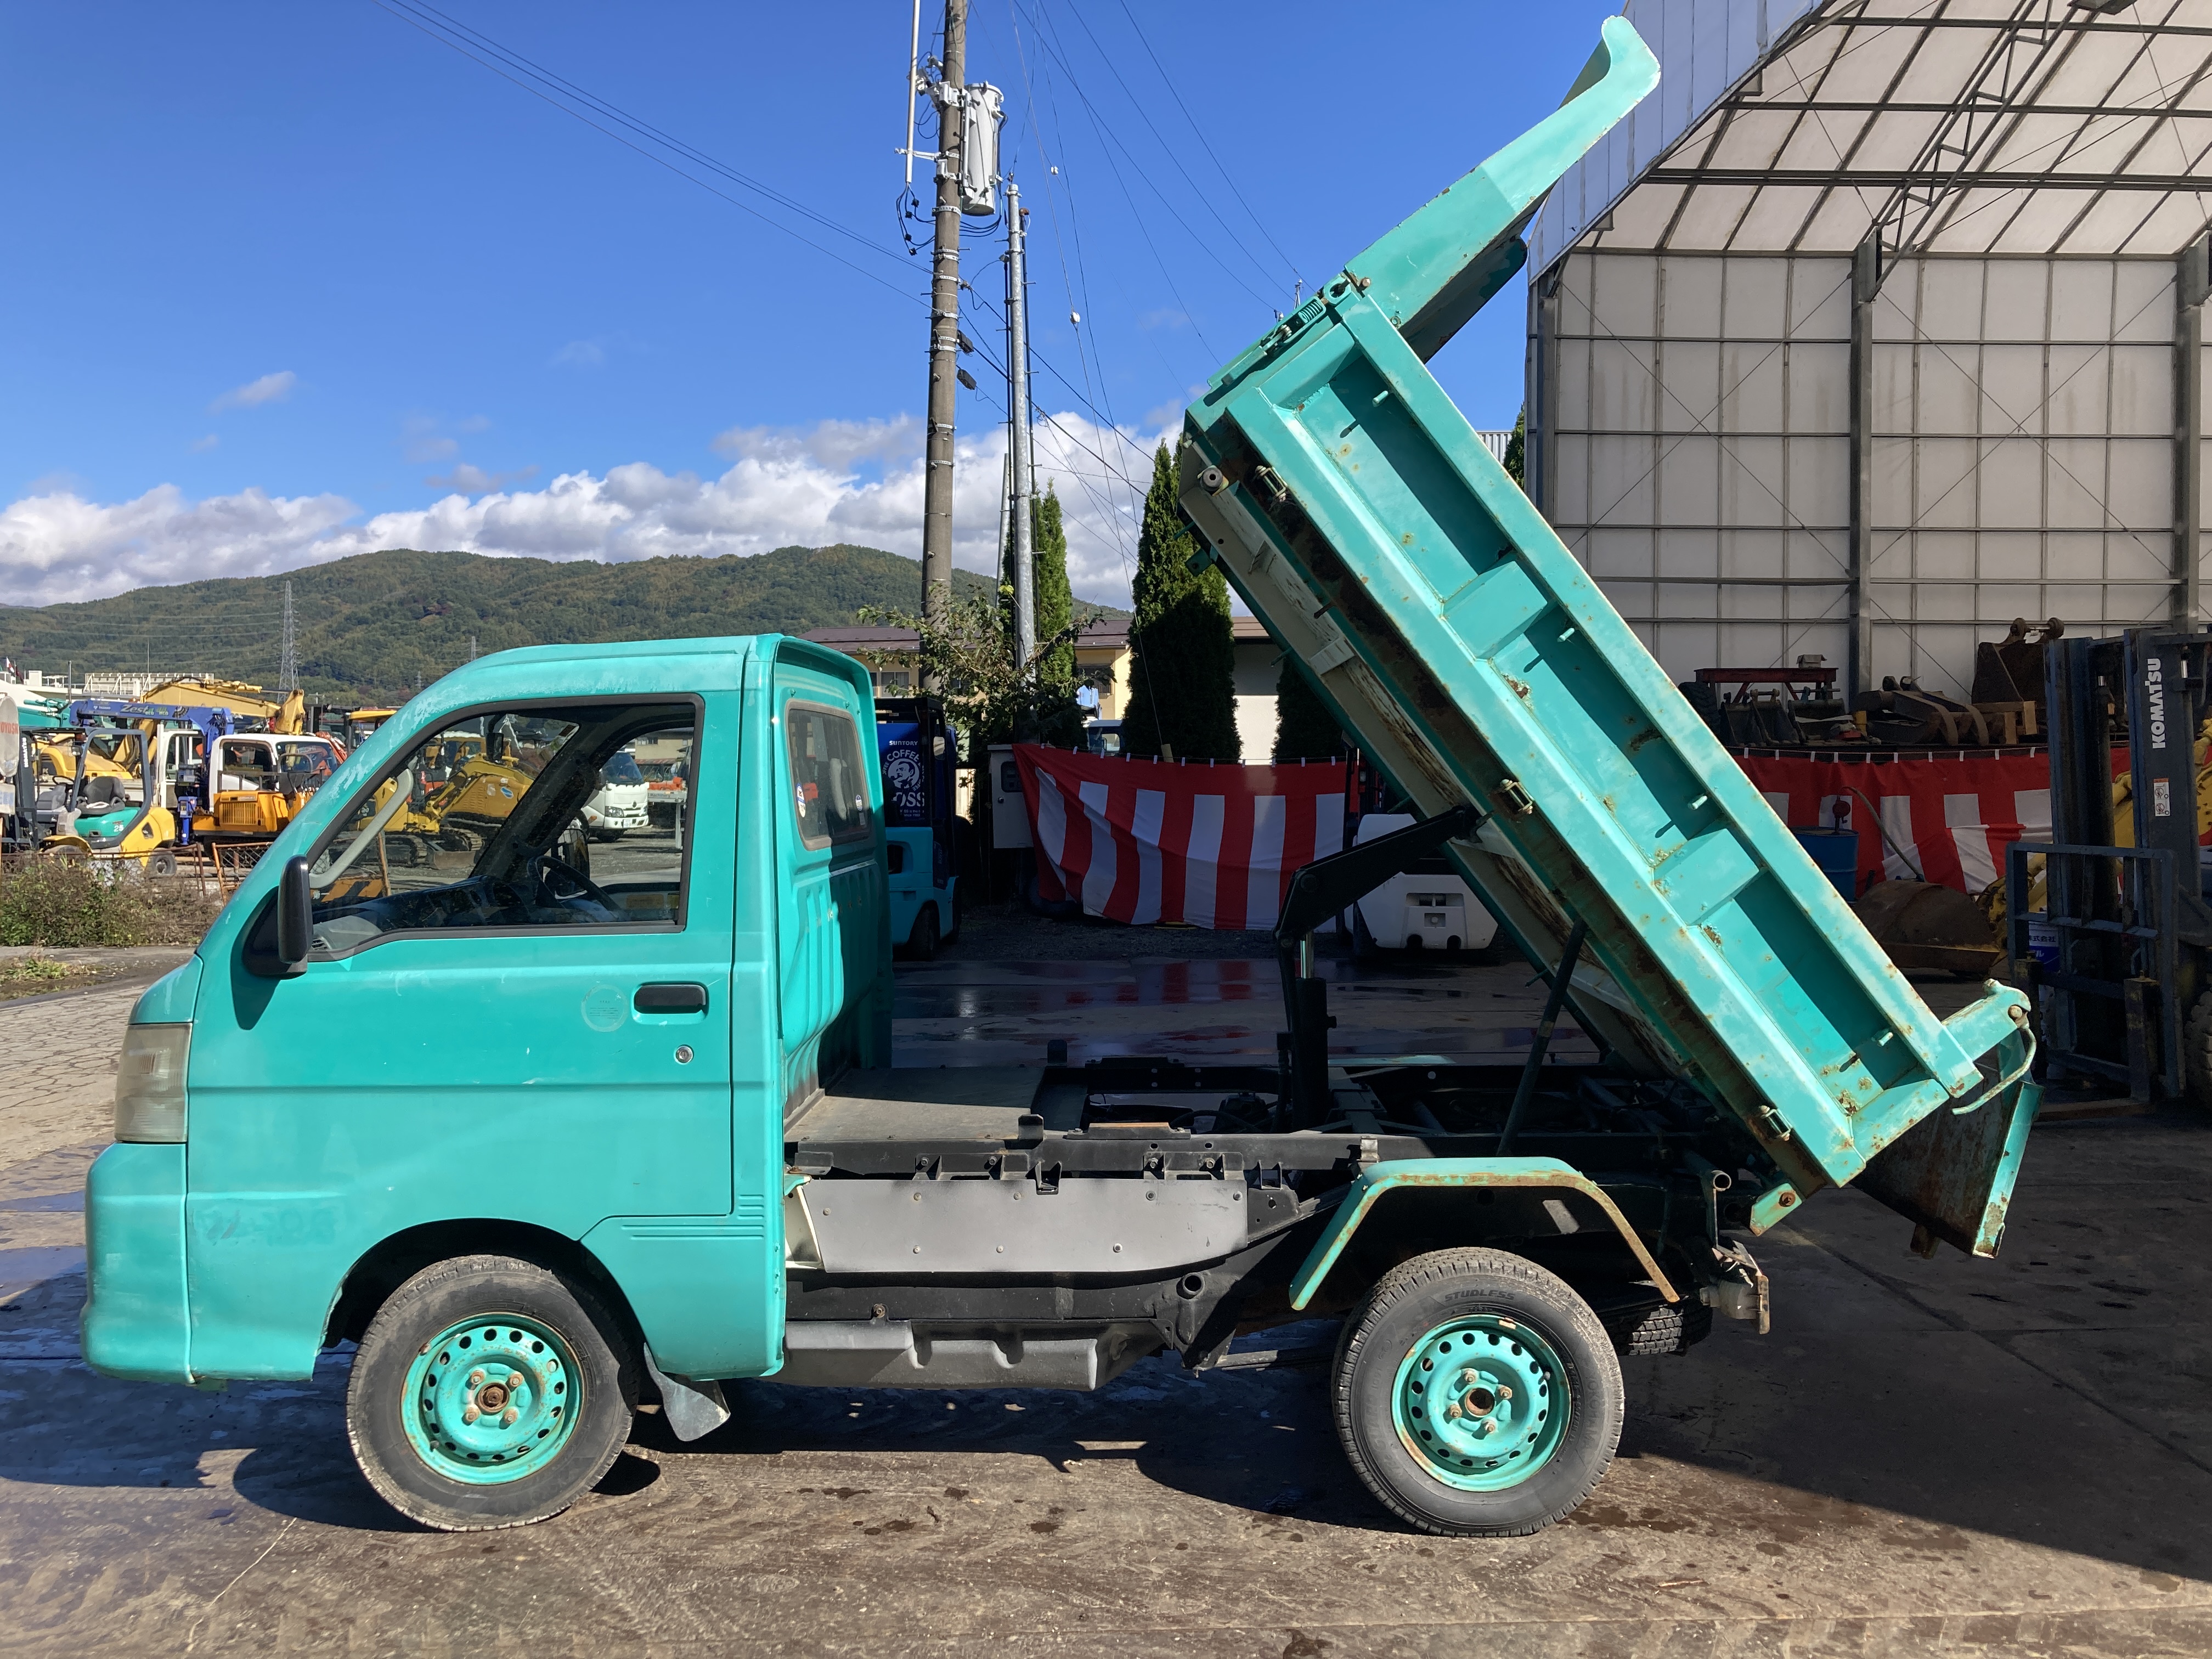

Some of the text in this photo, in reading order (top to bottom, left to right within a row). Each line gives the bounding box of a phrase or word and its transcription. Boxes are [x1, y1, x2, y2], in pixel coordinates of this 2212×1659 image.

[120, 704, 149, 714] Zest
[2145, 658, 2166, 749] KOMATSU
[887, 749, 919, 763] COFFEE
[891, 792, 925, 807] OSS
[1444, 1289, 1516, 1302] STUDLESS
